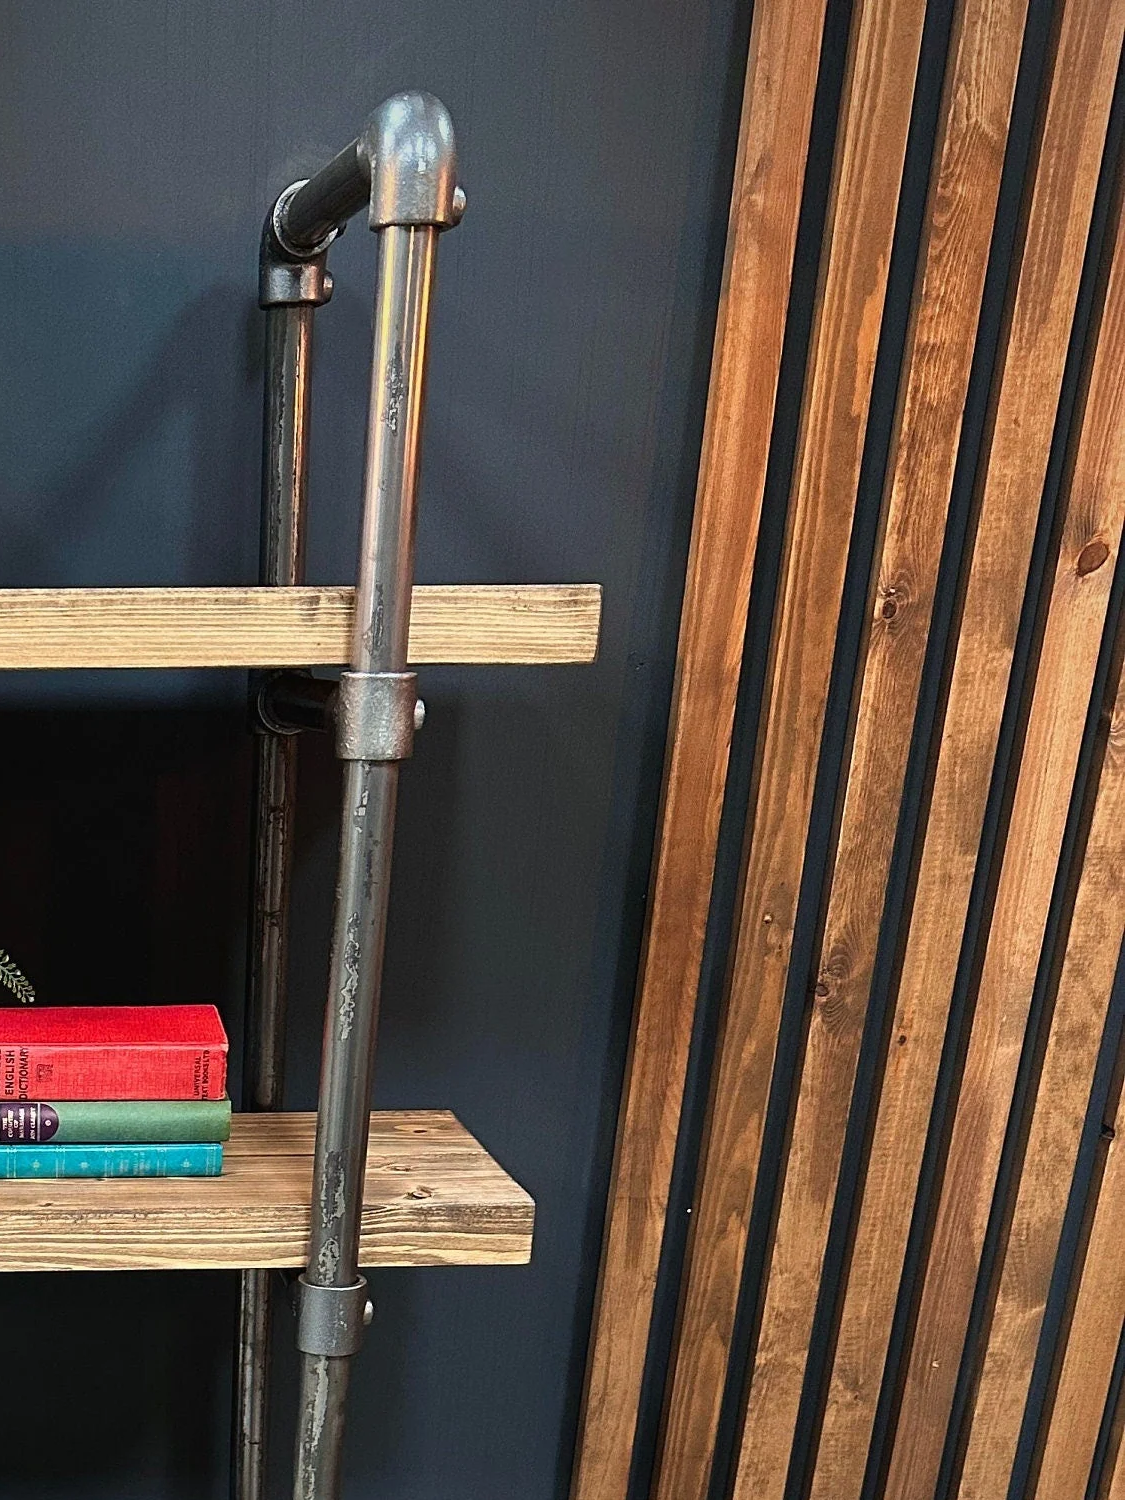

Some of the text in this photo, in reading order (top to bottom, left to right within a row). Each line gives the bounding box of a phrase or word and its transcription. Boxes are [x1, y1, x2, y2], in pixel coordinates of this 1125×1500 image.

[4, 1049, 15, 1096] ENGLISH
[18, 1046, 30, 1100] DICTIONARY
[193, 1056, 201, 1096] UNIVERSAL
